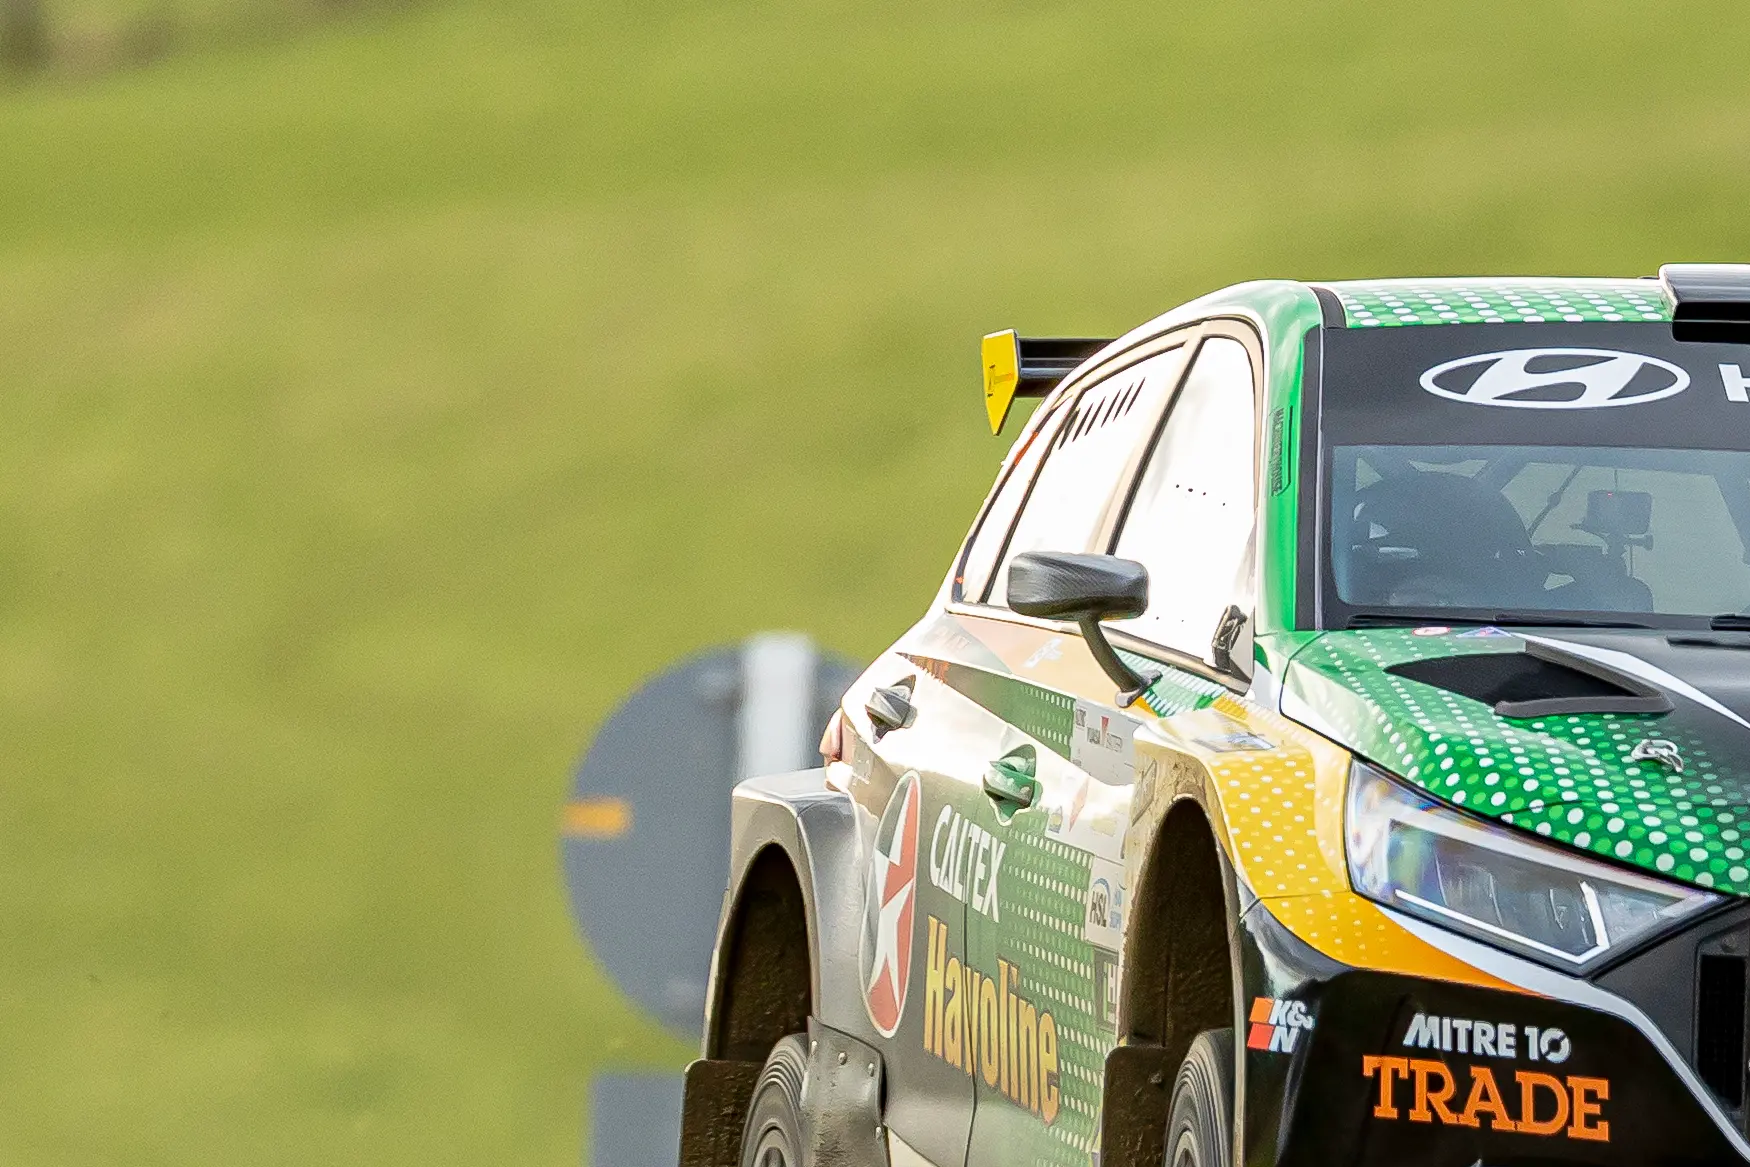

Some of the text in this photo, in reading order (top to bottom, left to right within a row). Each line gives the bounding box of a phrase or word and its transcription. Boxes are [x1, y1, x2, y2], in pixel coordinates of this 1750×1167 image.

[930, 804, 1007, 923] CALTEX
[923, 915, 1061, 1125] Havoline
[1403, 1012, 1572, 1064] MITRE 10
[1362, 1054, 1611, 1143] TRADE
